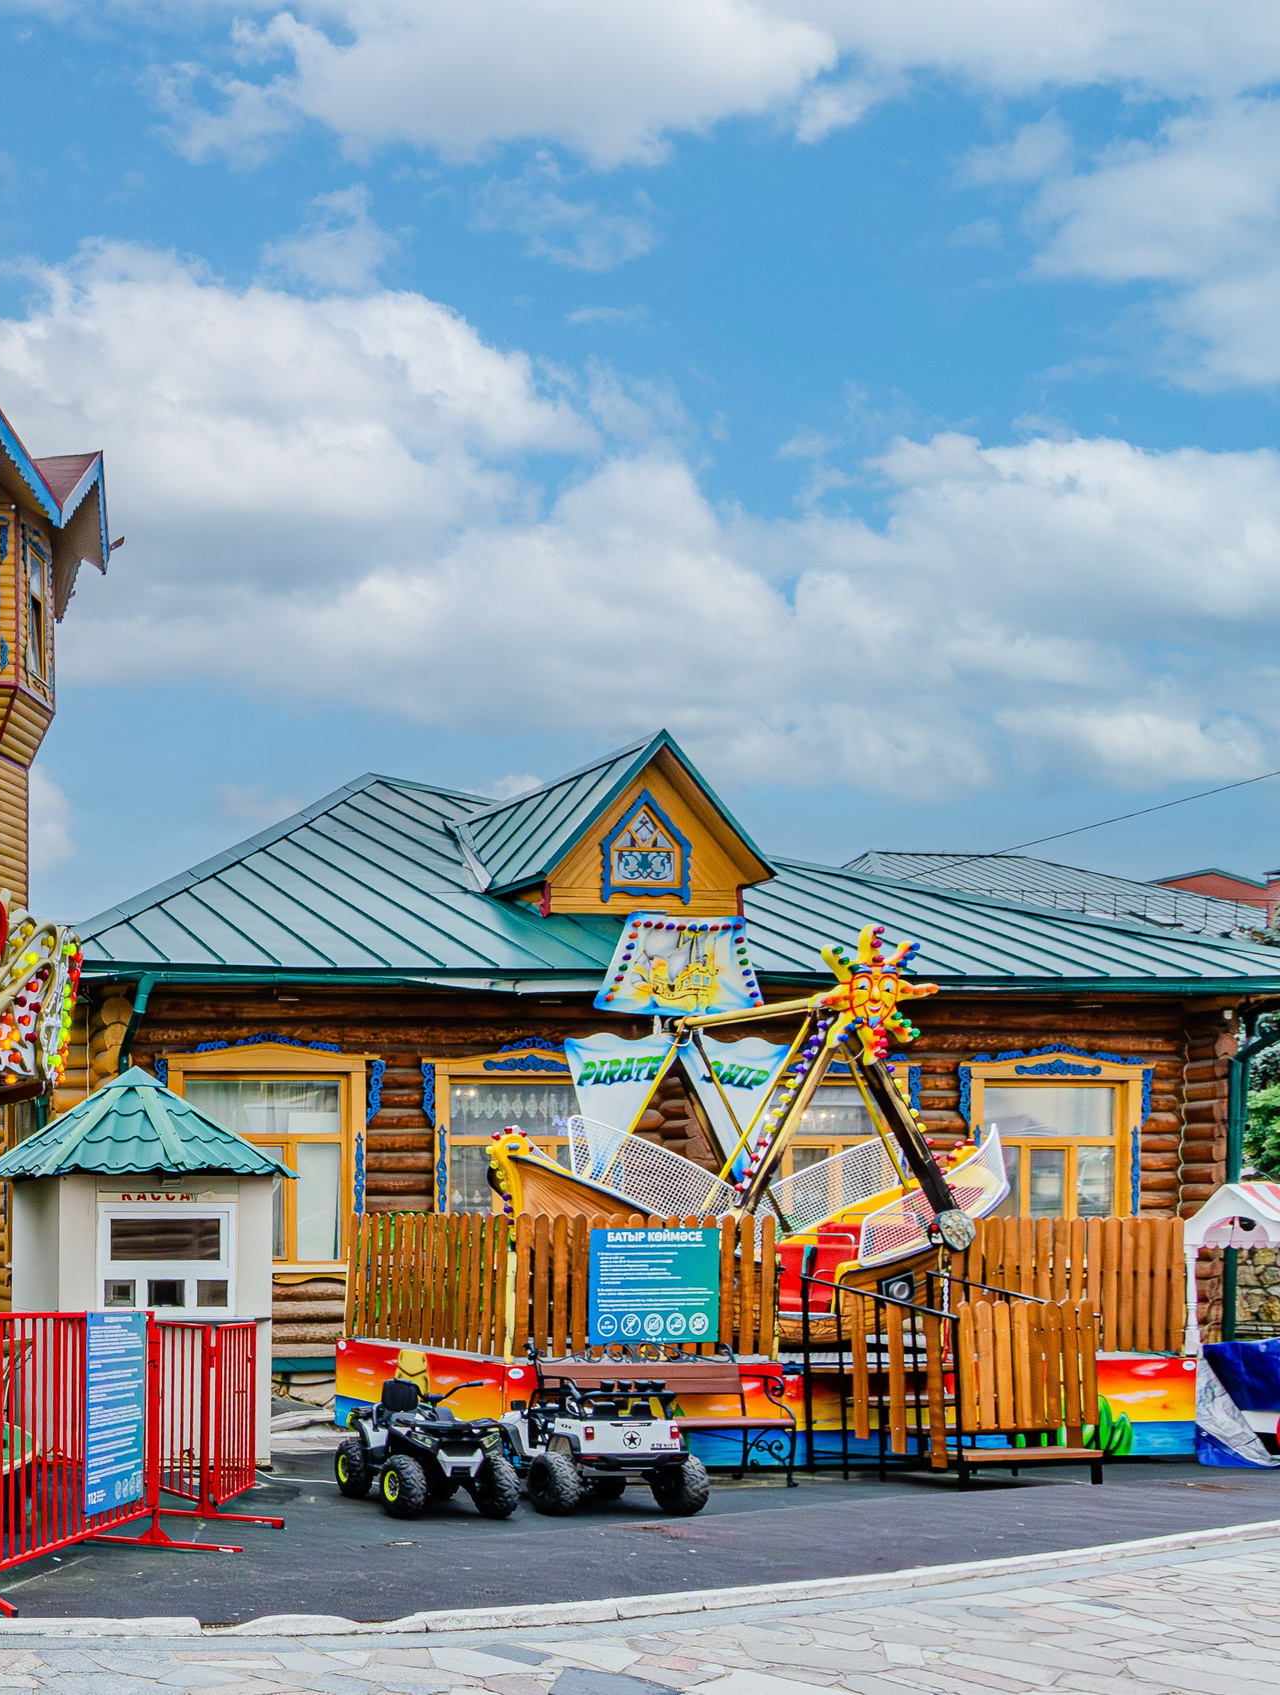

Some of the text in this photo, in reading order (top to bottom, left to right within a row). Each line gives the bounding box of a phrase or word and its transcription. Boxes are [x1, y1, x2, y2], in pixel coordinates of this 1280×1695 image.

[577, 1055, 771, 1091] PIRATE SHIP
[607, 1231, 646, 1242] БАТЫР
